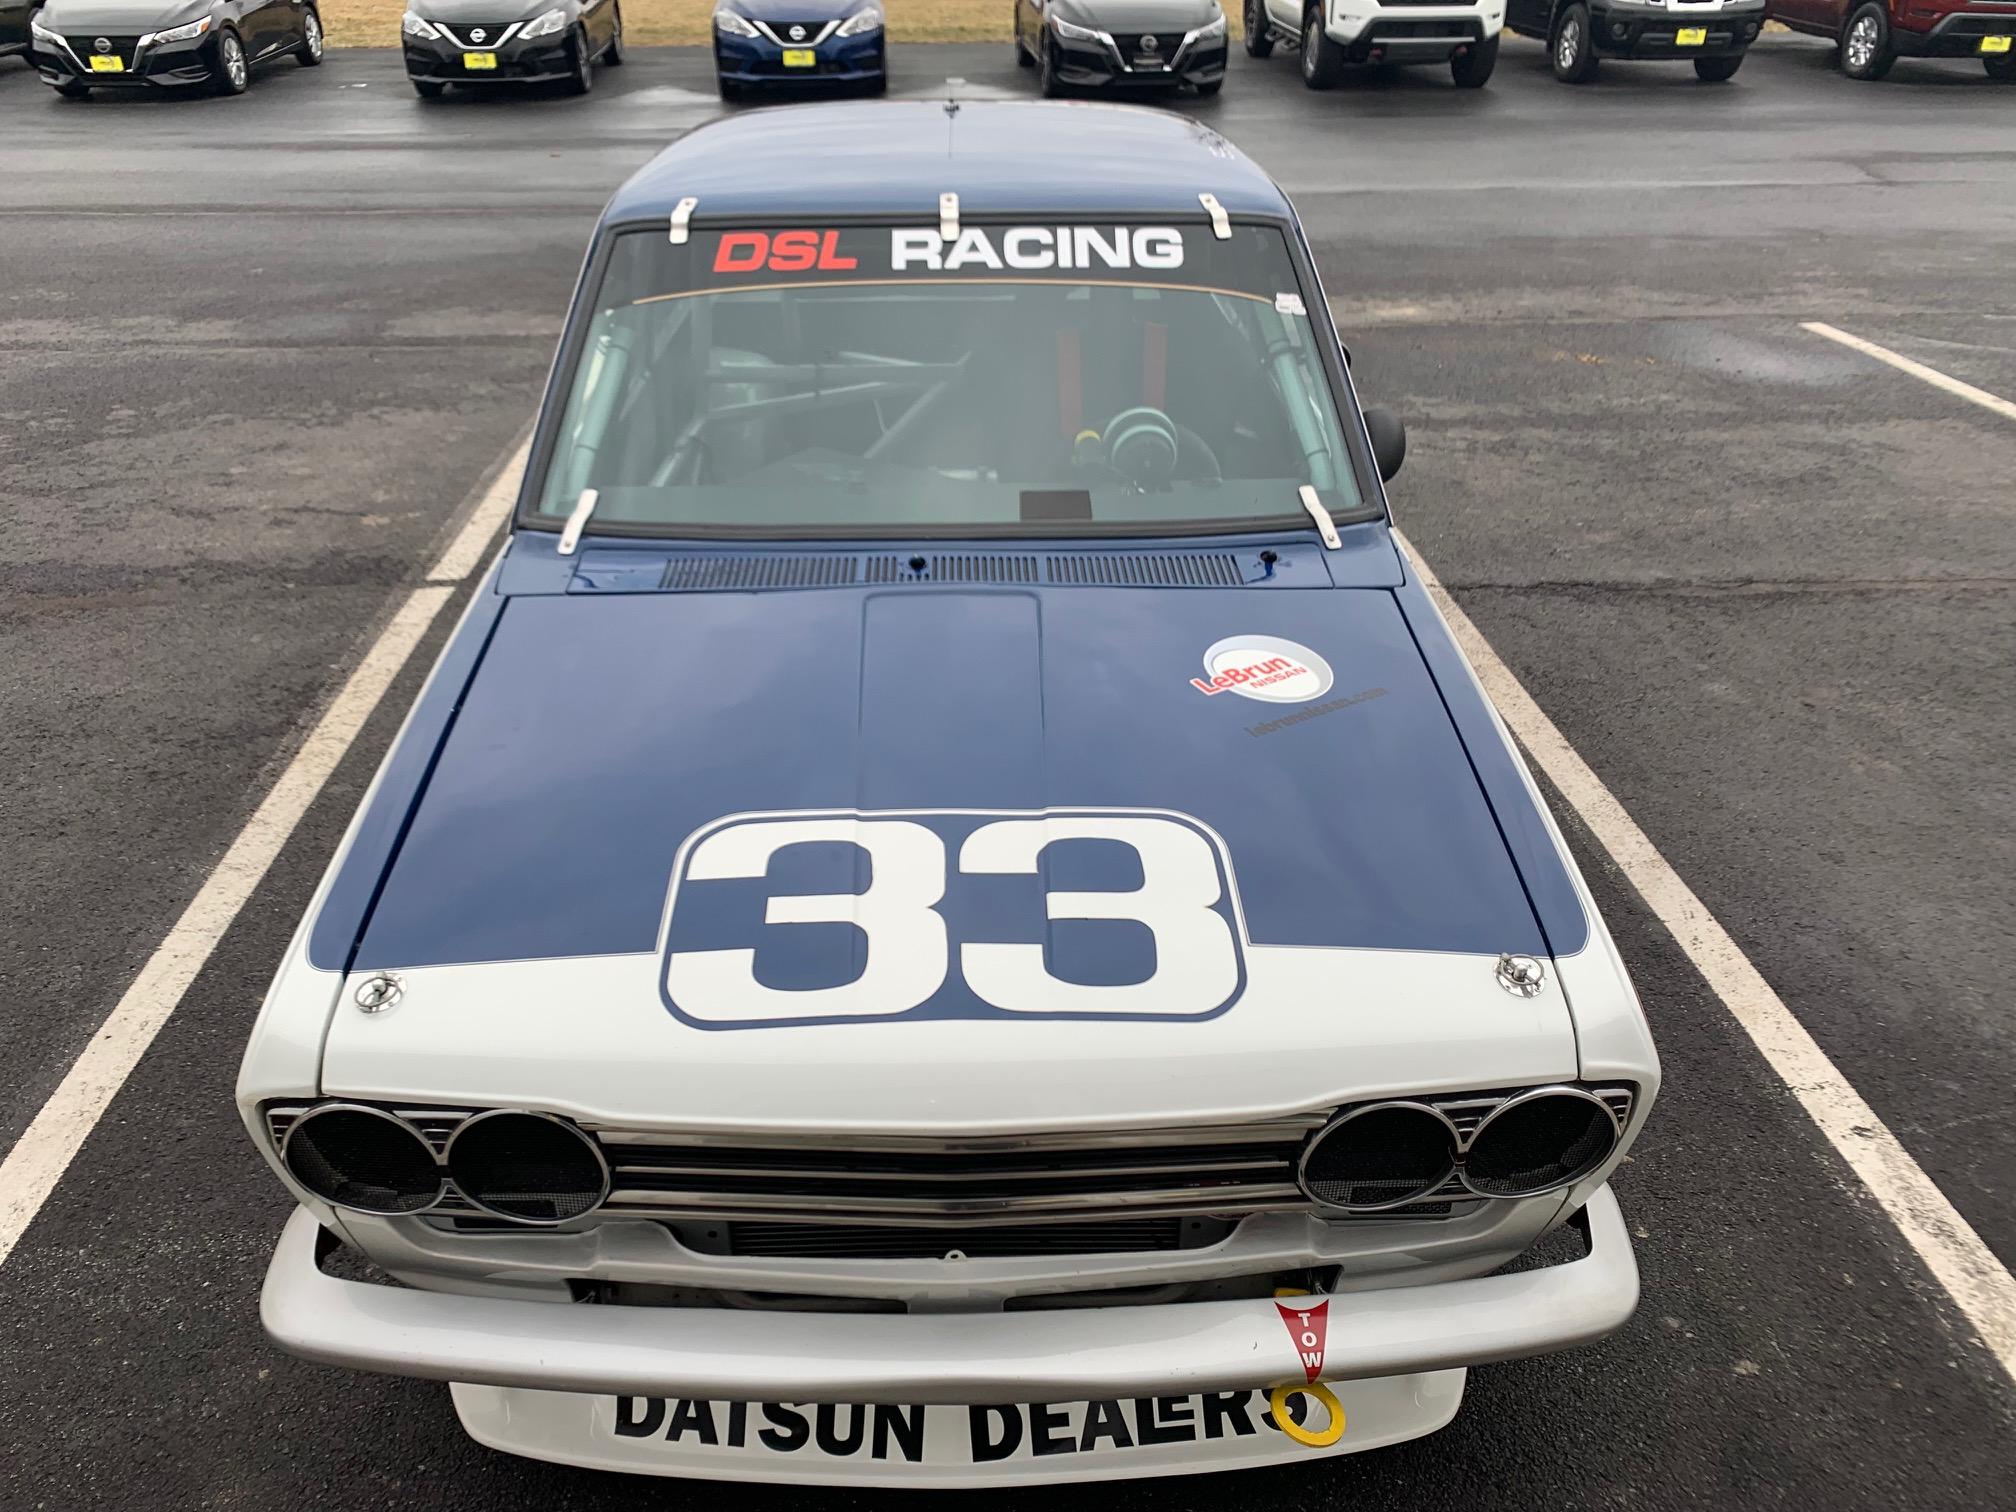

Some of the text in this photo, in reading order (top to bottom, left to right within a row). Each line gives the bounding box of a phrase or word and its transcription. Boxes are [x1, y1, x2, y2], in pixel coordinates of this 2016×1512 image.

[713, 226, 1185, 272] DSL RACING
[1192, 657, 1293, 694] LeBrun
[1249, 666, 1308, 689] NISSAN
[666, 817, 1239, 1022] 33
[1297, 1312, 1322, 1368] TOW
